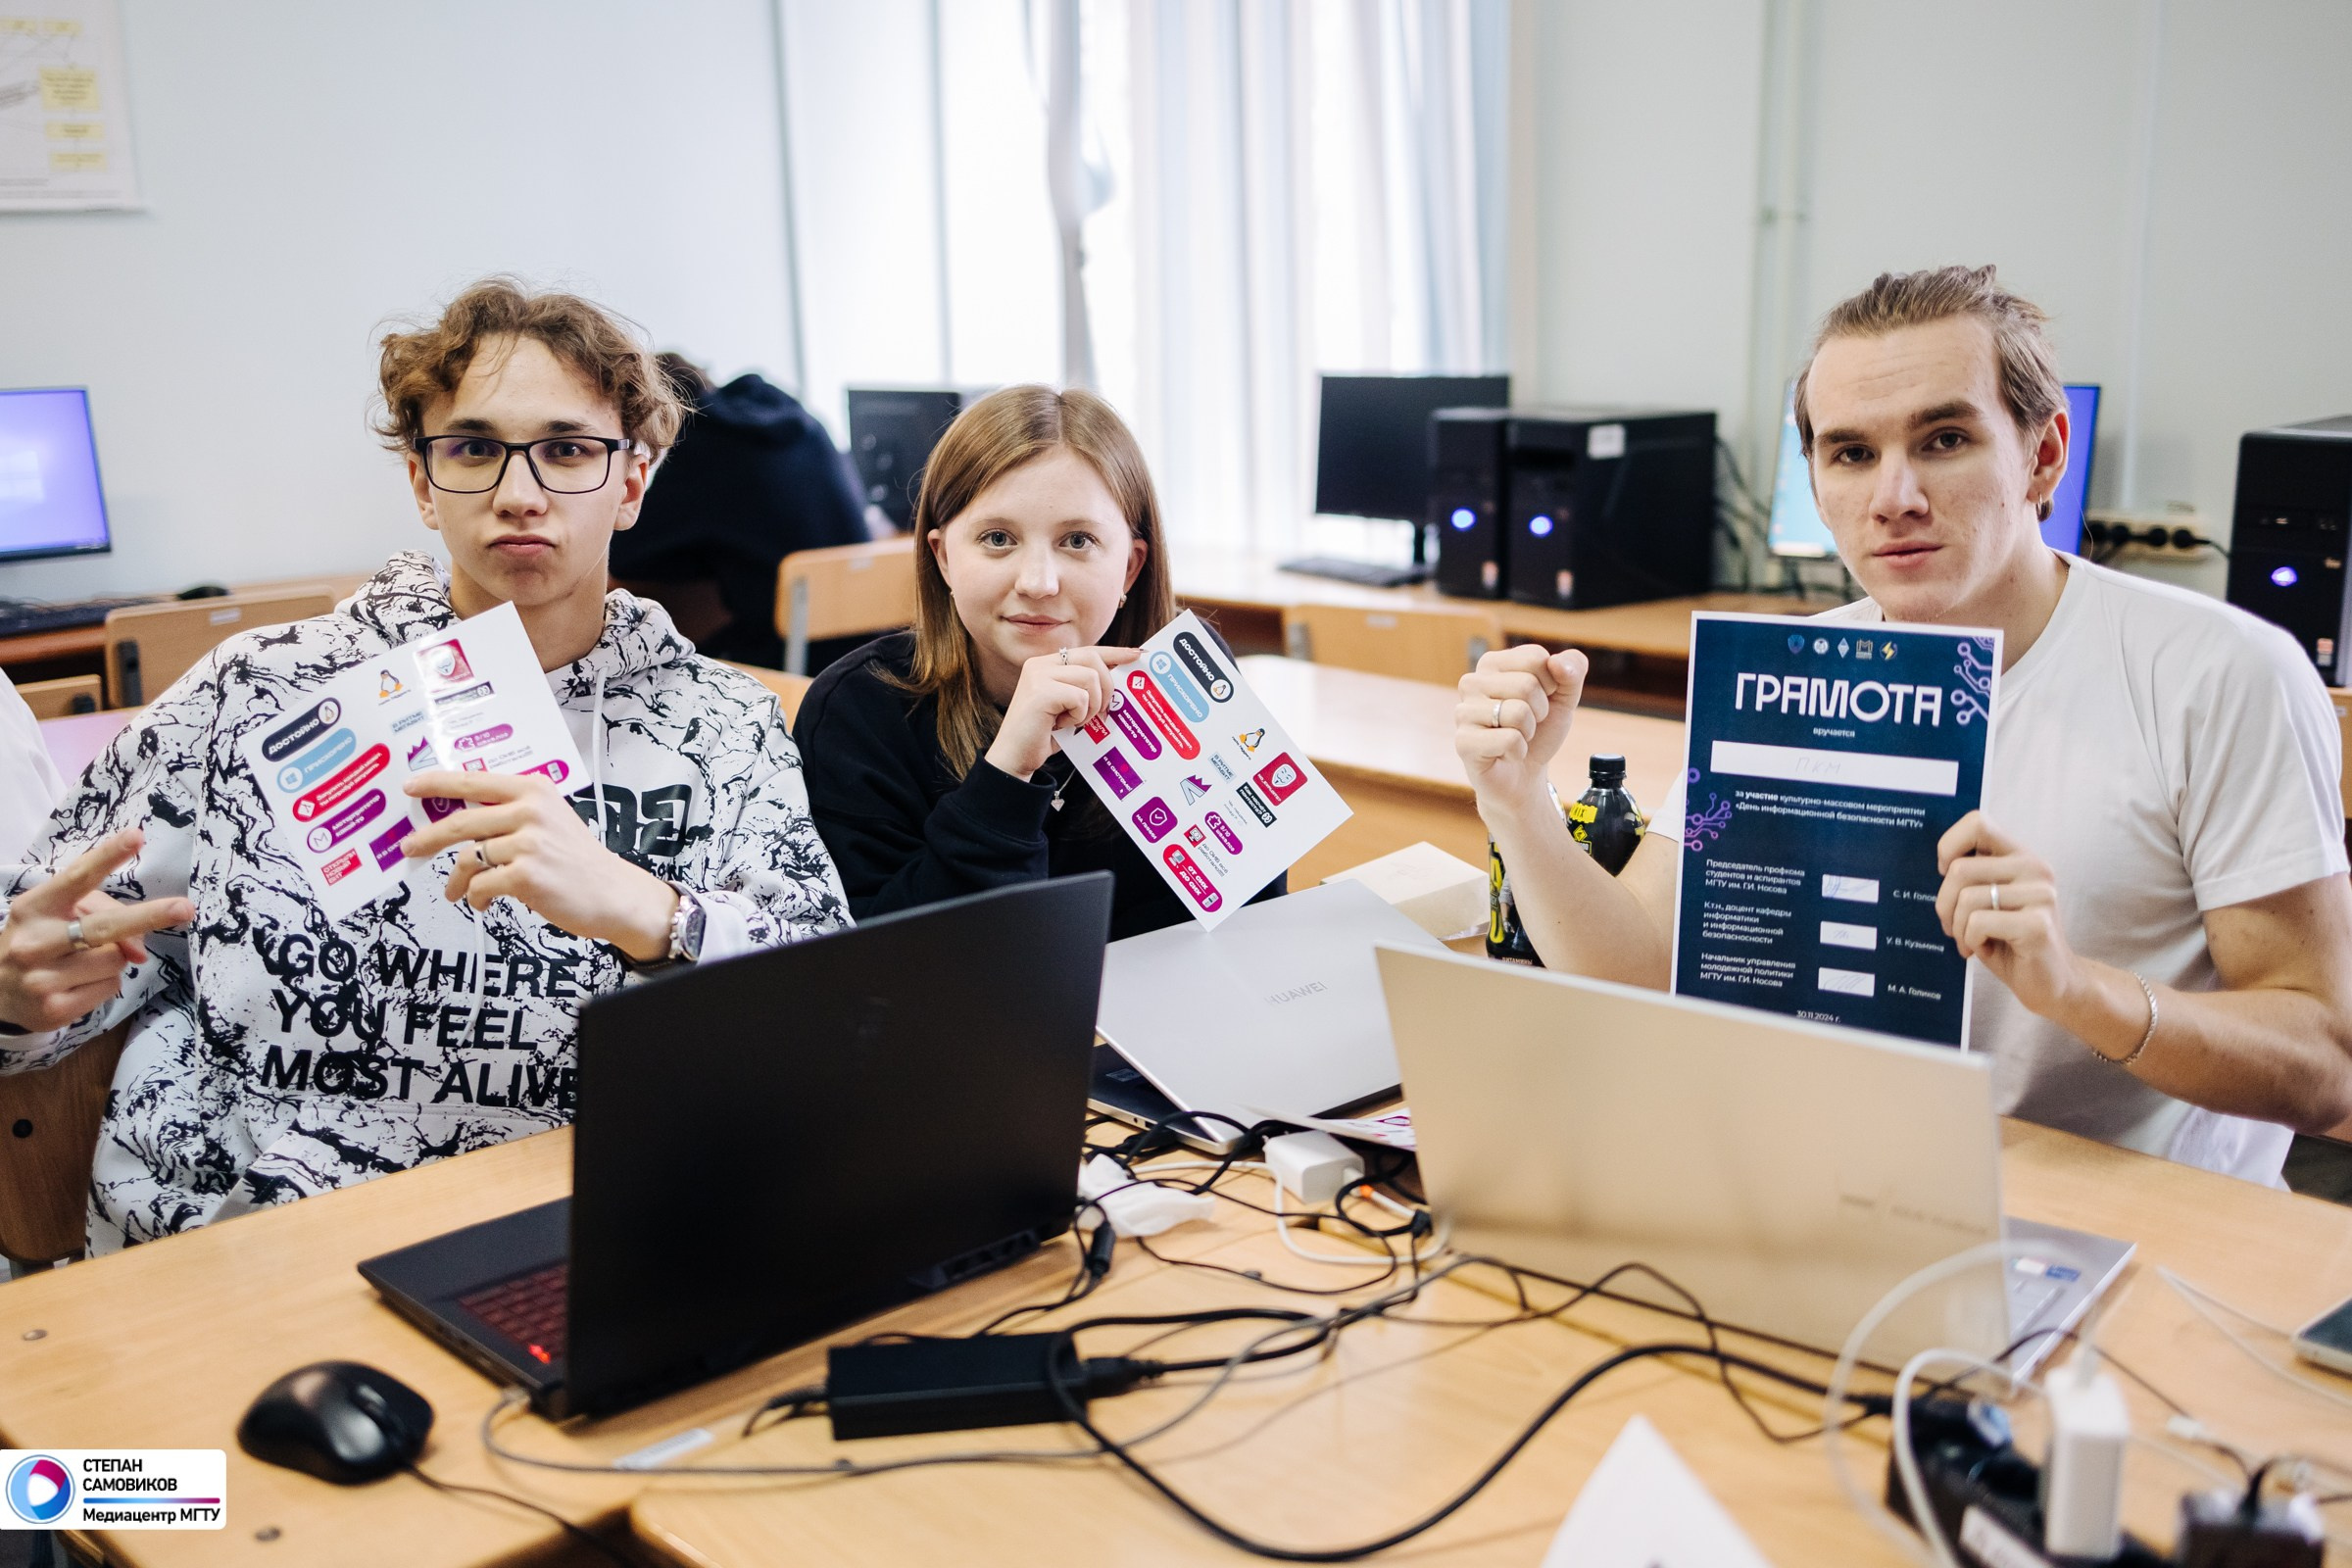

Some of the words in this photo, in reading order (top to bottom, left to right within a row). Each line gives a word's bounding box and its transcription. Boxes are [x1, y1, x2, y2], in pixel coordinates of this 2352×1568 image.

[1178, 636, 1215, 682] ДОСТОЙНО
[1166, 672, 1203, 718] ПРИСКОРБНО
[1736, 673, 1942, 726] ГРАМОТА
[267, 716, 320, 755] ДОСТОЙНО
[1813, 728, 1855, 738] вручается
[1209, 757, 1230, 781] МЕГАБИТ
[1217, 759, 1233, 777] РИТМЕ
[1243, 785, 1252, 796] Как
[1745, 793, 1778, 802] участие
[1780, 795, 1865, 811] культурно-массовом
[1867, 803, 1926, 816] мероприятии
[1736, 802, 1760, 812] «День
[1761, 804, 1835, 820] информационной
[1837, 811, 1894, 826] безопасности
[1896, 819, 1923, 829] МГТУ»
[322, 850, 356, 873] ОТКРЫЛИ
[1706, 859, 1762, 873] Председатель
[1764, 865, 1805, 878] профкома
[1705, 869, 1743, 881] студентов
[1754, 874, 1801, 887] аспирантов
[1705, 879, 1727, 888] МГТУ
[1742, 883, 1756, 892] Г.И.
[1758, 885, 1787, 895] Носова
[1703, 911, 1759, 924] информатики
[1726, 905, 1754, 914] доцент
[1756, 906, 1791, 919] кафедры
[1710, 921, 1784, 937] информационной
[1894, 938, 1903, 947] В.
[1904, 939, 1944, 953] Кузьмина
[277, 933, 358, 983] GO
[375, 947, 579, 999] WHERE
[1701, 953, 1745, 964] Начальник
[1746, 957, 1795, 970] управления
[1700, 971, 1722, 982] МГТУ
[1739, 975, 1752, 985] Г.И.
[1753, 977, 1783, 988] Носова
[1701, 963, 1752, 976] молодежной
[1755, 968, 1793, 979] политики
[1263, 981, 1328, 1004] HUAWEI
[1887, 984, 1898, 993] М.
[1898, 986, 1907, 995] А.
[1908, 988, 1941, 1000] Голиков
[271, 988, 385, 1042] YOU
[404, 1003, 539, 1052] FEEL
[1796, 1010, 1834, 1022] 30.11.2024
[262, 1045, 429, 1101] MOST
